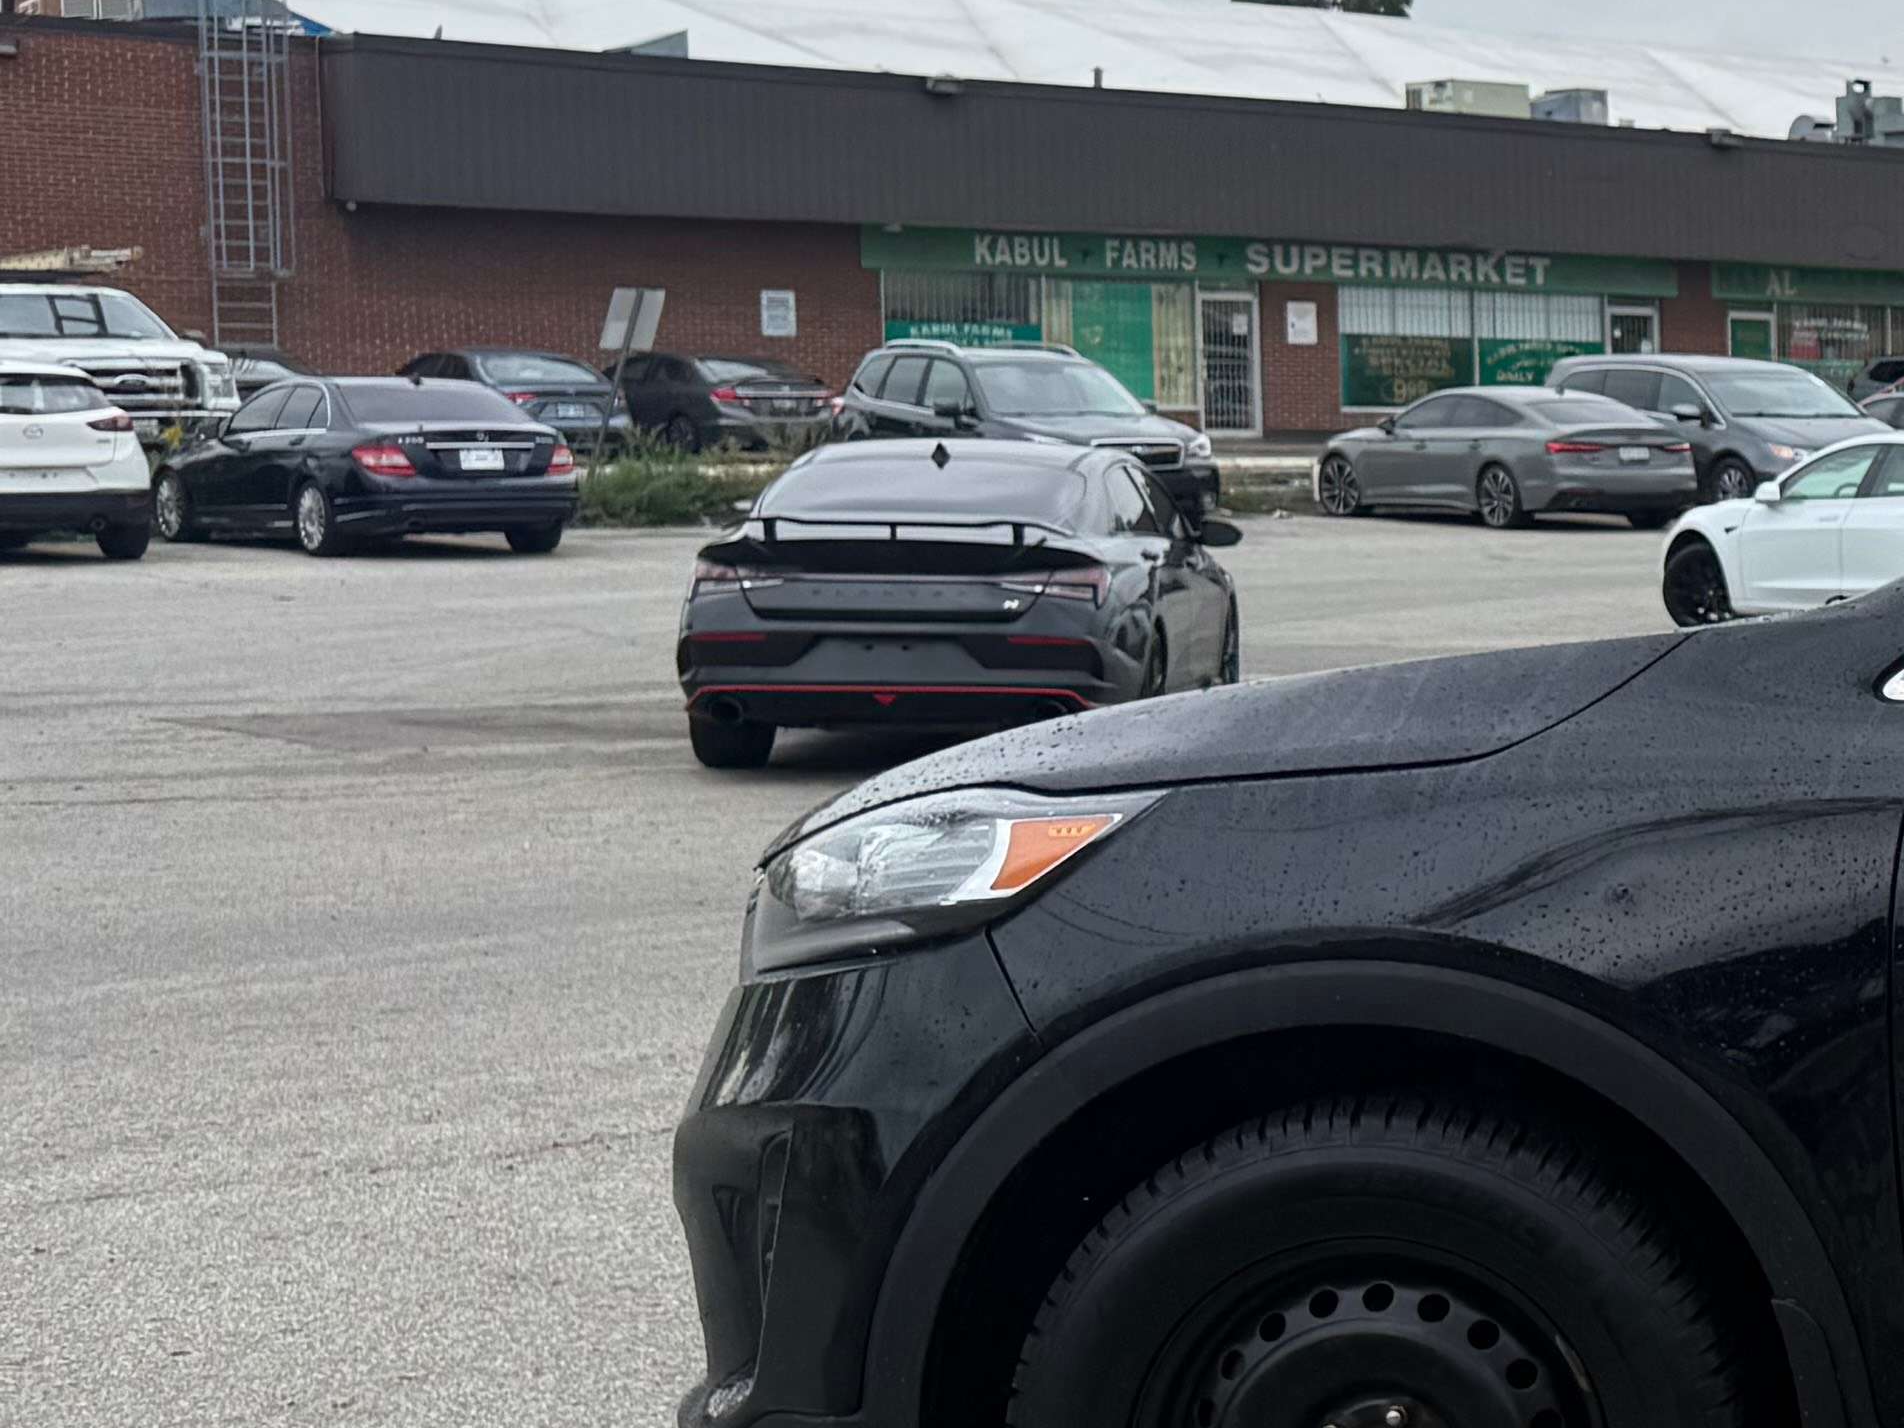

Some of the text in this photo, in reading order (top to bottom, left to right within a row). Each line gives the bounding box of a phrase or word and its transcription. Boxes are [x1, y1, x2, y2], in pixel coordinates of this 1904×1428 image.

[974, 234, 1551, 286] KABUL FARMS SUPERMARKET
